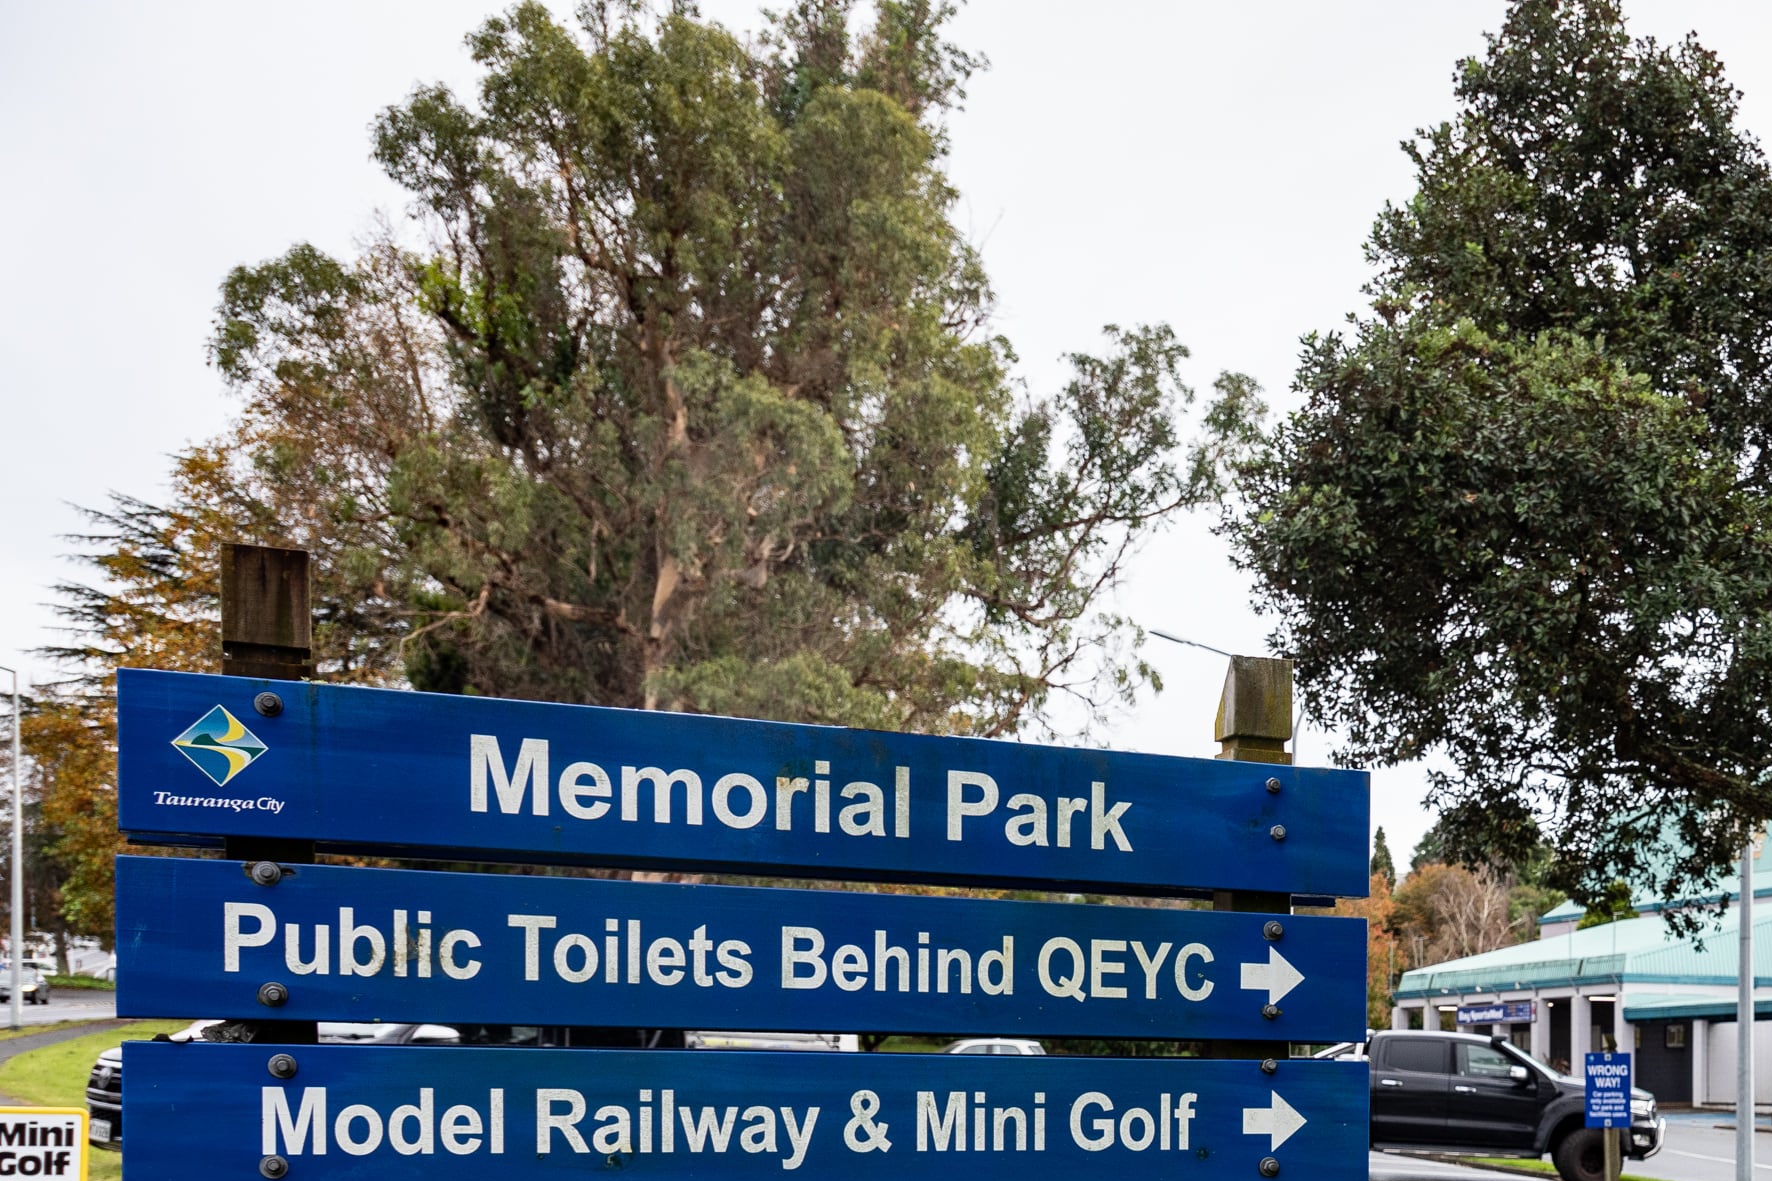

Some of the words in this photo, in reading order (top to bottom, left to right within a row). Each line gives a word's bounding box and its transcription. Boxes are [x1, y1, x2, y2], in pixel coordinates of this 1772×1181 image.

[153, 791, 255, 812] Tauranga
[256, 797, 285, 814] City
[470, 733, 911, 839] Memorial
[947, 769, 1135, 854] Park
[224, 901, 483, 982] Public
[507, 914, 754, 989] Toilets
[781, 925, 1014, 996] Behind
[1037, 936, 1216, 1003] QEYC
[1587, 1064, 1628, 1077] WRONG
[1594, 1077, 1621, 1088] WAY!
[0, 1122, 75, 1147] Mini
[261, 1086, 505, 1156] Model
[536, 1087, 821, 1170] Railway
[843, 1089, 893, 1153] &
[916, 1090, 1046, 1152] Mini
[1069, 1091, 1198, 1152] Golf
[0, 1151, 71, 1176] Golf
